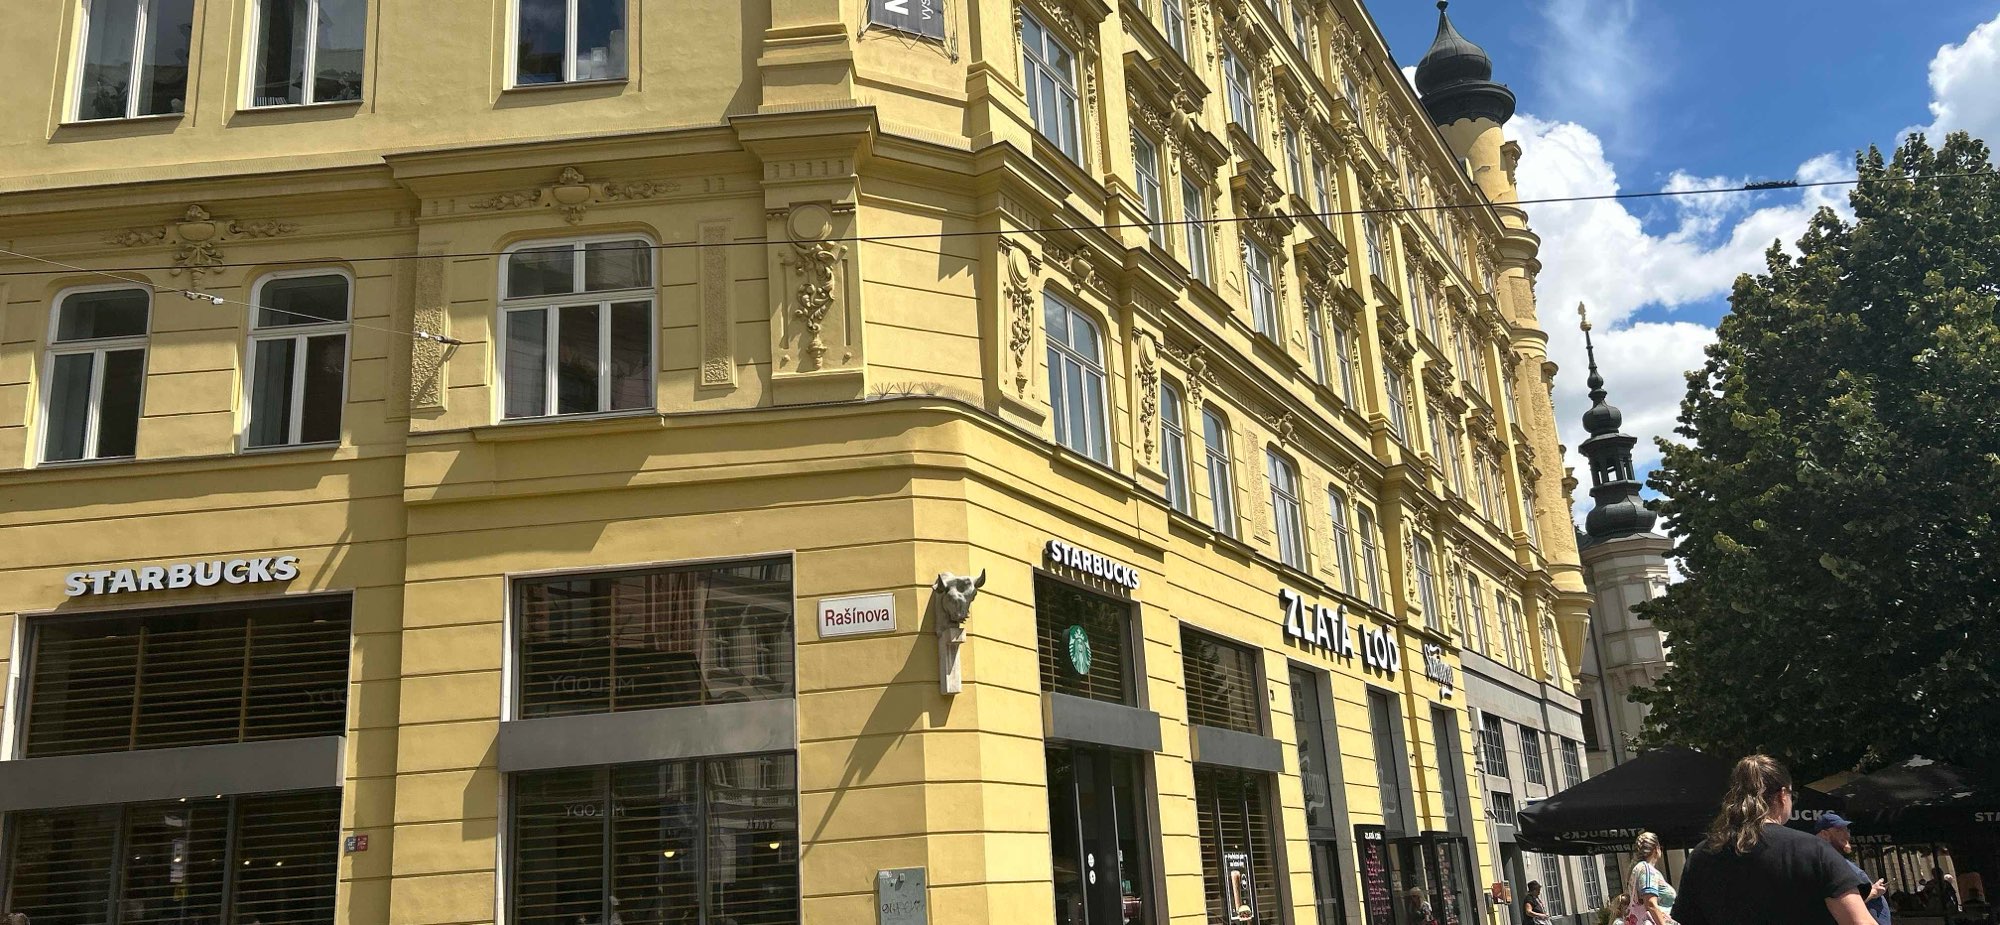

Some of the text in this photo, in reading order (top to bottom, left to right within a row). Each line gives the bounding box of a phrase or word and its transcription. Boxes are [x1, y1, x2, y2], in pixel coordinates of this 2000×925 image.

[65, 556, 298, 596] STARBUCKS
[1049, 540, 1140, 590] STARBUCKS
[825, 607, 889, 626] Rašínova
[1280, 588, 1354, 658] ZLATÁ
